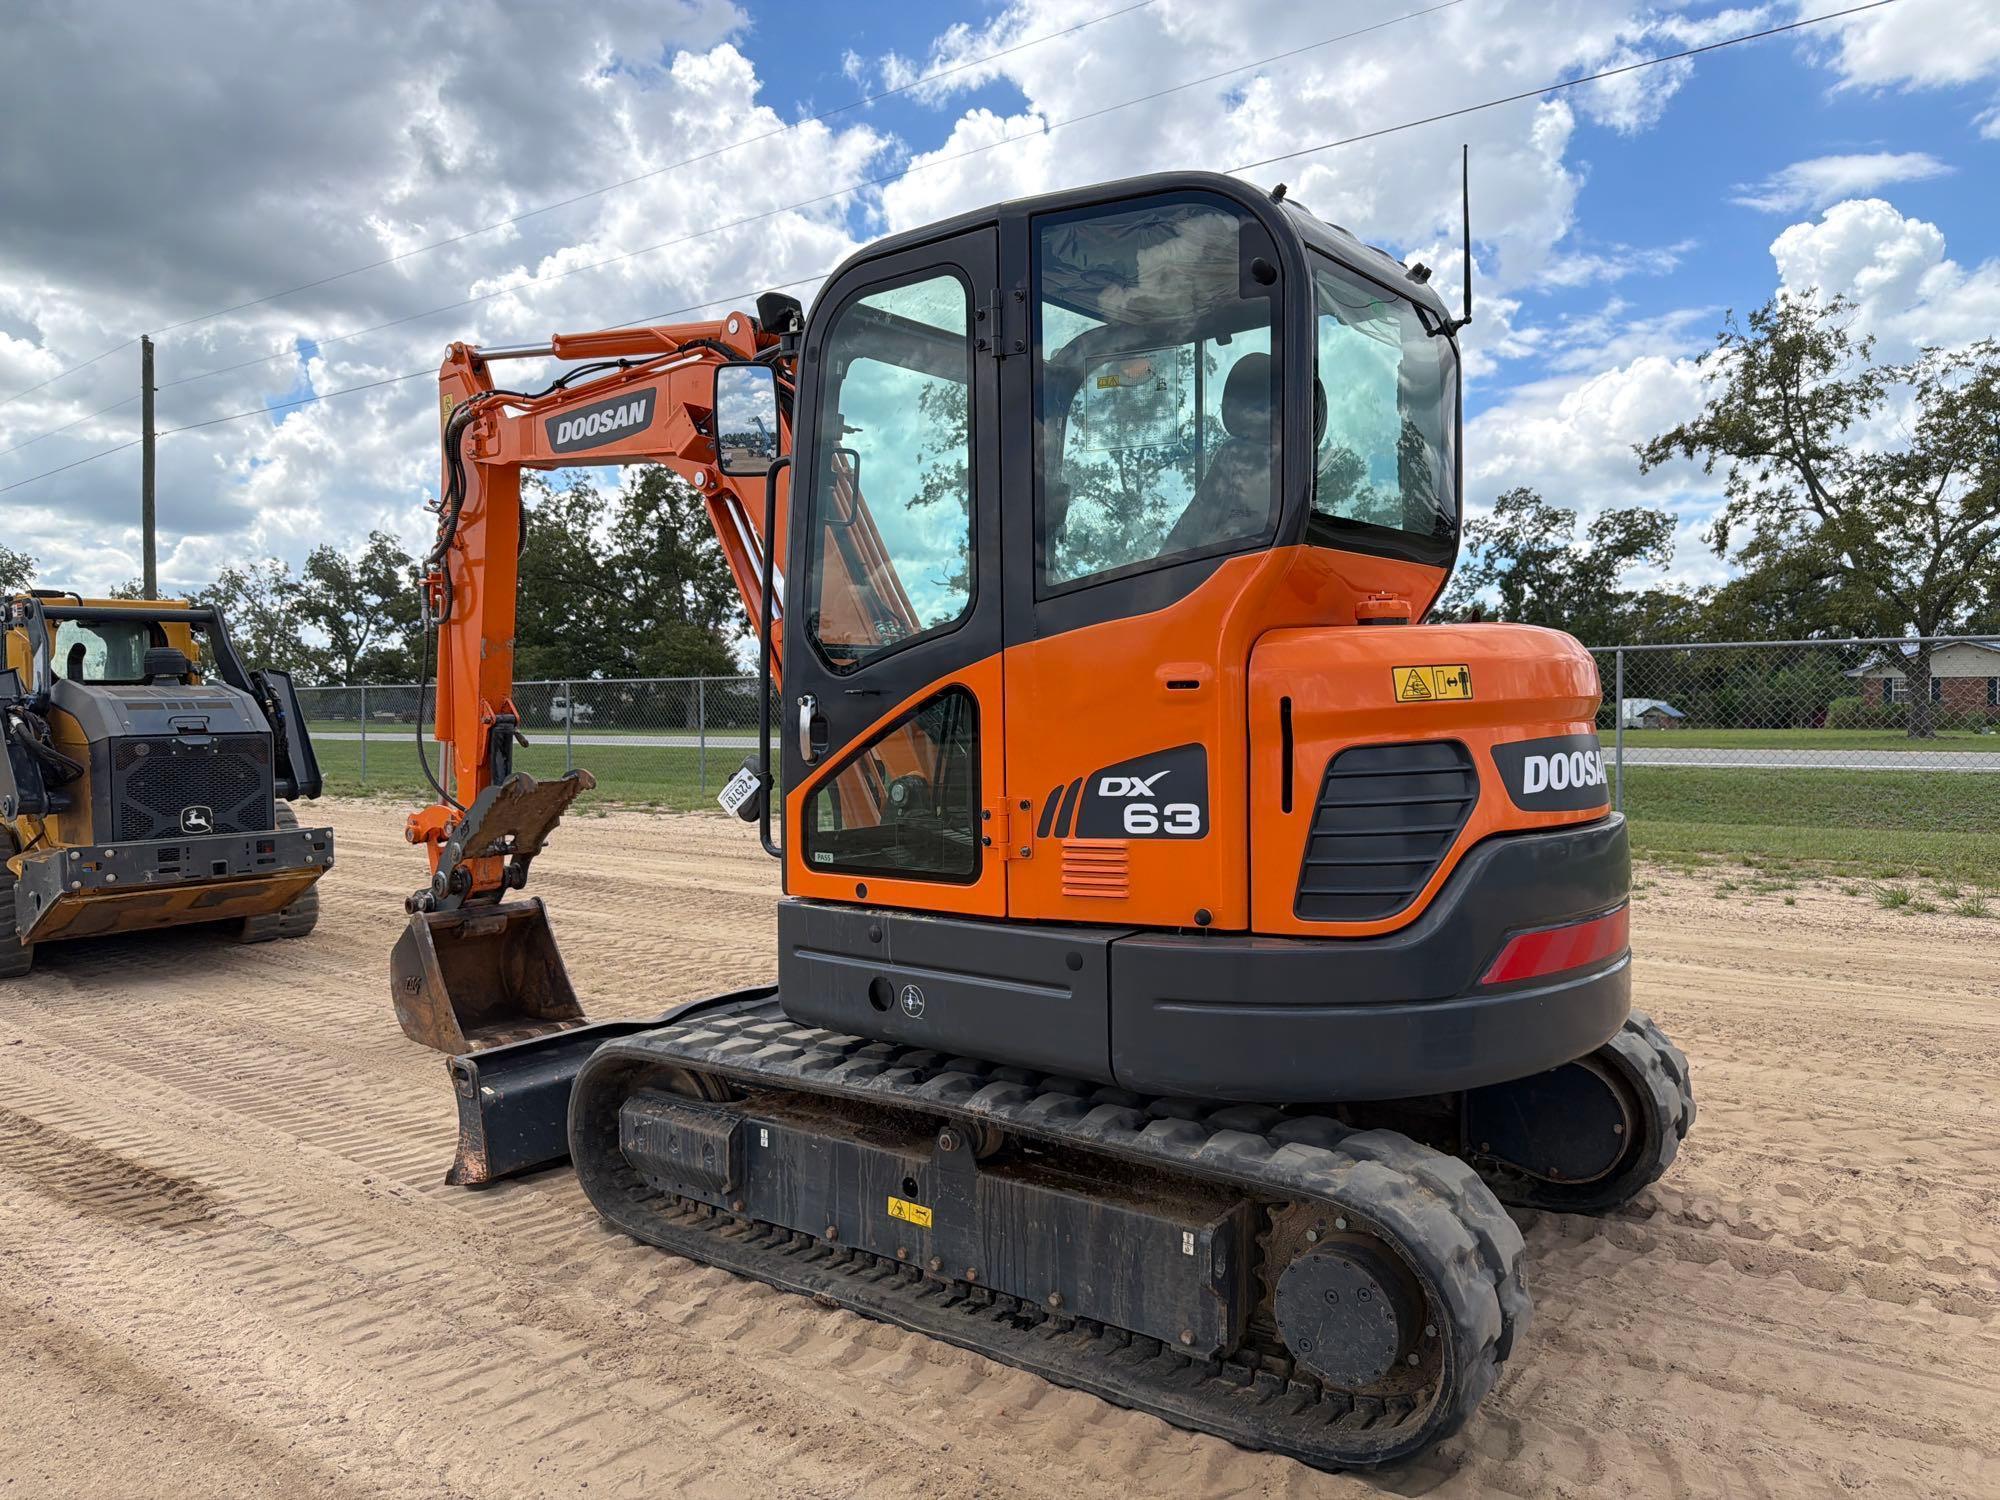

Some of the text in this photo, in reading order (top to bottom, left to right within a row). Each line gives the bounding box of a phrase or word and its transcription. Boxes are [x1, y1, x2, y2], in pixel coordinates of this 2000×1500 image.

[556, 399, 647, 445] DOOSAN
[1098, 770, 1171, 797] DX
[1523, 750, 1608, 795] DOOSA
[725, 779, 752, 809] 225787
[1123, 803, 1200, 834] 63
[816, 853, 832, 862] PASS
